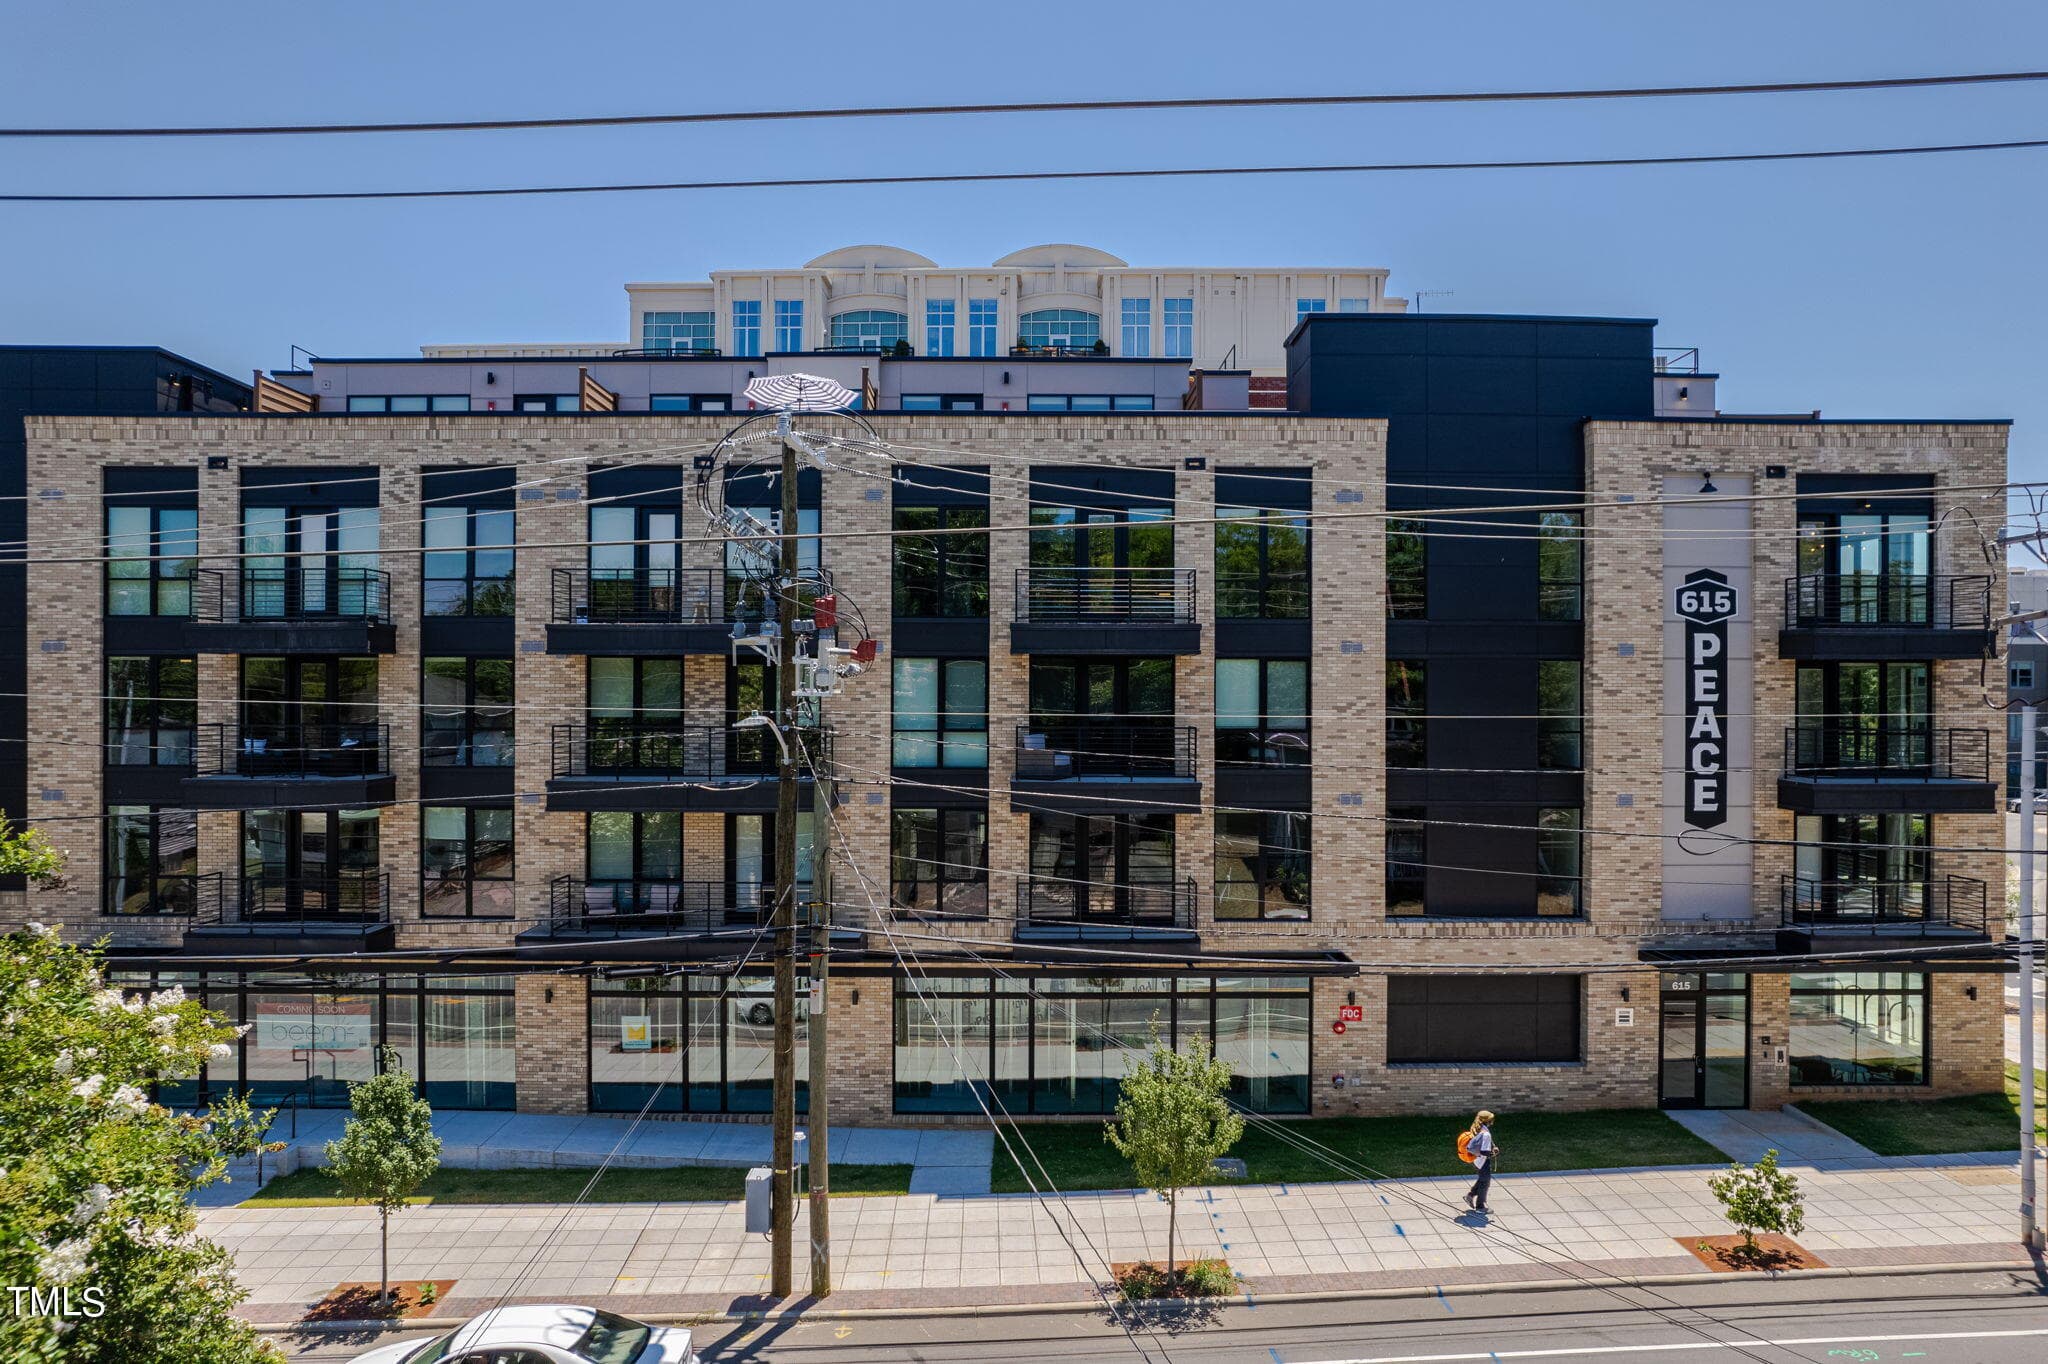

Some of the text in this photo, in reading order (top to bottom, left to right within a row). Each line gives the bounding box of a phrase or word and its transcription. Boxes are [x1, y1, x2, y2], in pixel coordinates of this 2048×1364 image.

[1681, 591, 1731, 613] 615
[1690, 633, 1722, 812] PEACE
[1671, 981, 1691, 990] 615
[277, 1005, 346, 1014] COMING SOON
[1342, 1009, 1360, 1018] FDC
